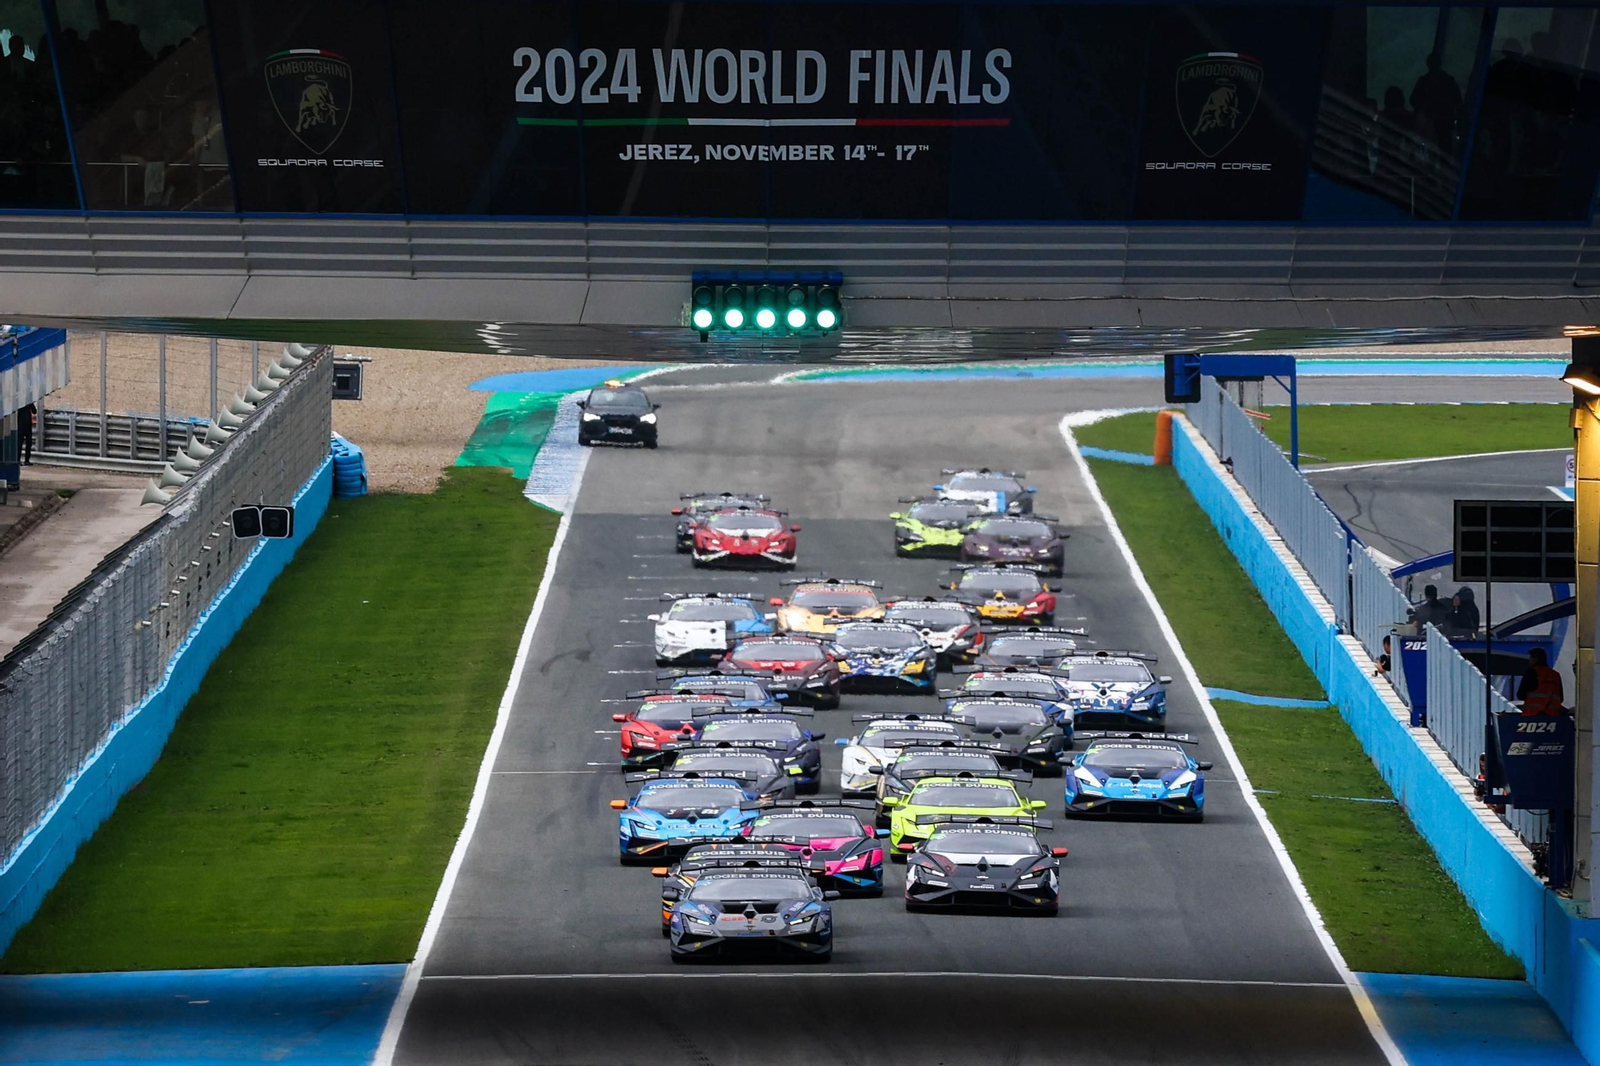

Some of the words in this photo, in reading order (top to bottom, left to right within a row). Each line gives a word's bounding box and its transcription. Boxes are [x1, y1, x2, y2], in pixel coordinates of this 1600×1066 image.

[269, 60, 347, 79] LAMBORGHINI
[1181, 64, 1260, 83] LAMBORGHINI
[513, 47, 641, 104] 2024
[652, 48, 827, 104] WORLD
[849, 48, 1012, 104] FINALS
[619, 144, 700, 164] JEREZ,
[706, 145, 835, 162] NOVEMBER
[257, 158, 328, 167] SQUADRA
[333, 159, 385, 168] CORSE
[1145, 162, 1216, 170] SQUADRA
[1221, 162, 1272, 171] CORSE
[1404, 641, 1427, 651] 202
[1516, 721, 1557, 733] 2024
[1114, 732, 1190, 742] radstad
[699, 739, 776, 748] radstad
[668, 770, 747, 779] radstad
[712, 835, 797, 843] radstad
[726, 859, 812, 868] radstad
